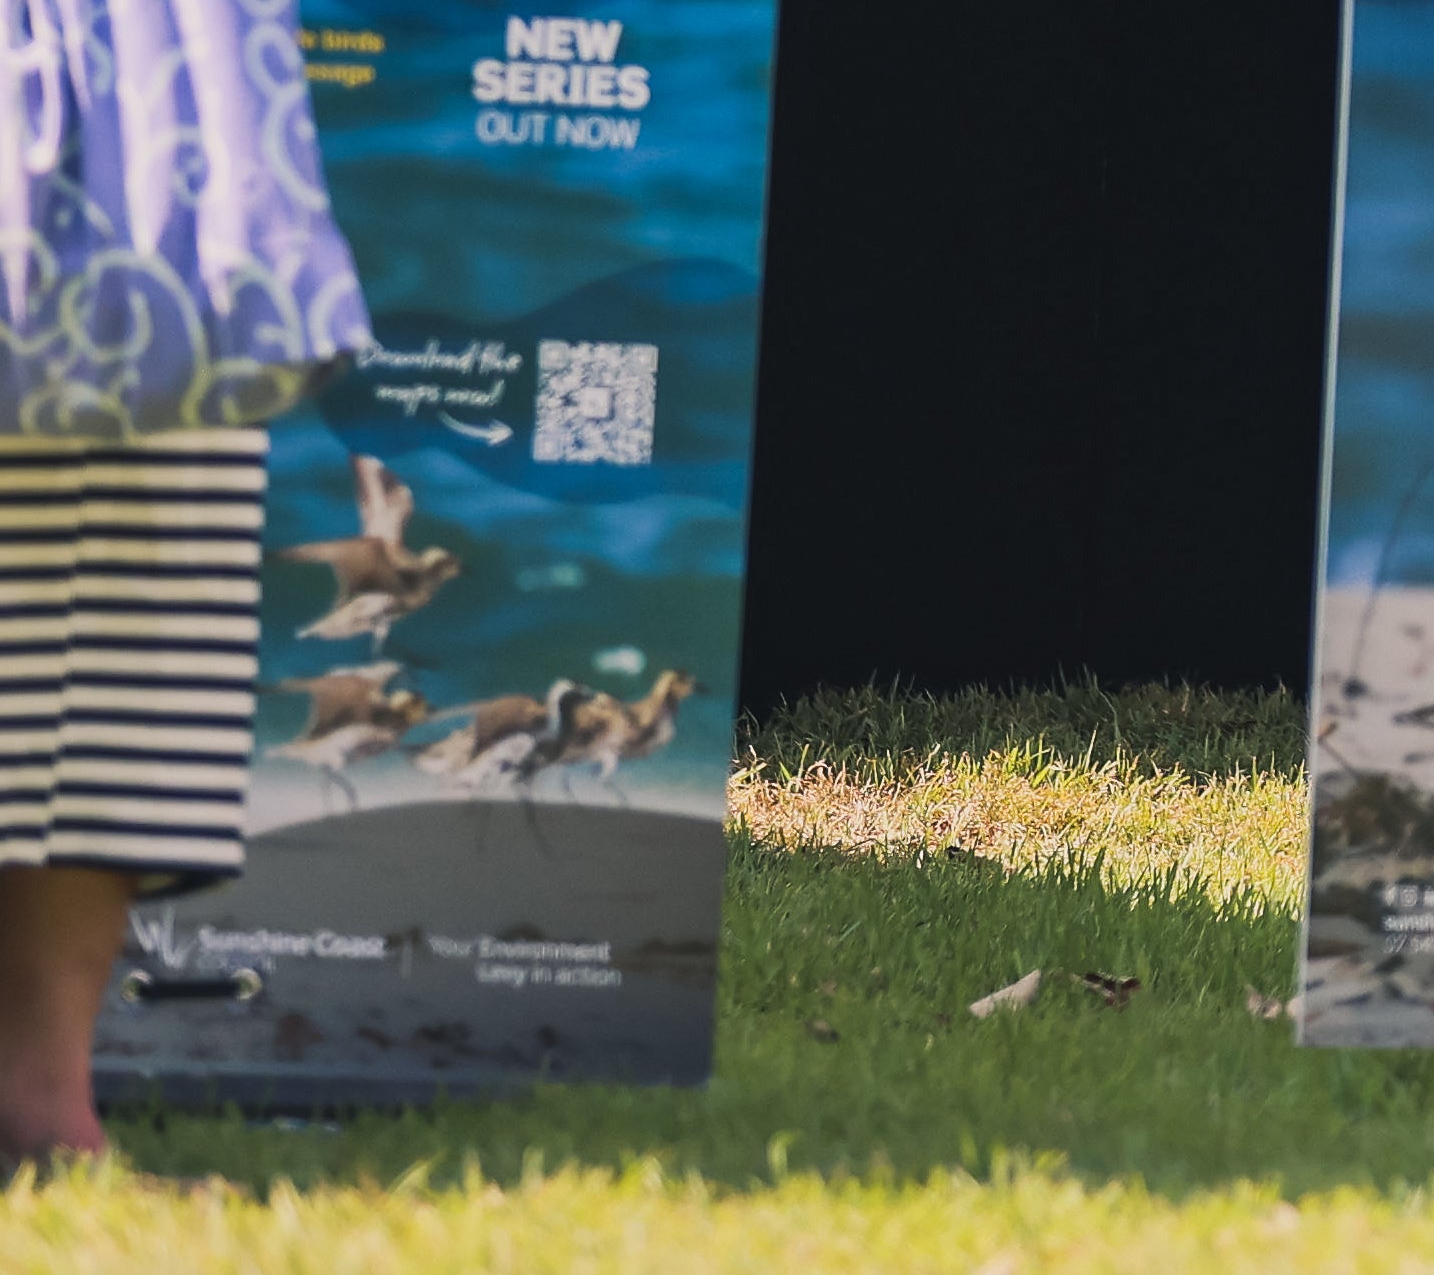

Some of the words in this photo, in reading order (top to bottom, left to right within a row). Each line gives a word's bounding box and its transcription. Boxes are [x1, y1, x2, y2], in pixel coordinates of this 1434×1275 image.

[505, 14, 624, 63] NEW
[472, 57, 652, 111] SERIES
[475, 106, 552, 145] OUT
[554, 114, 643, 151] NOW
